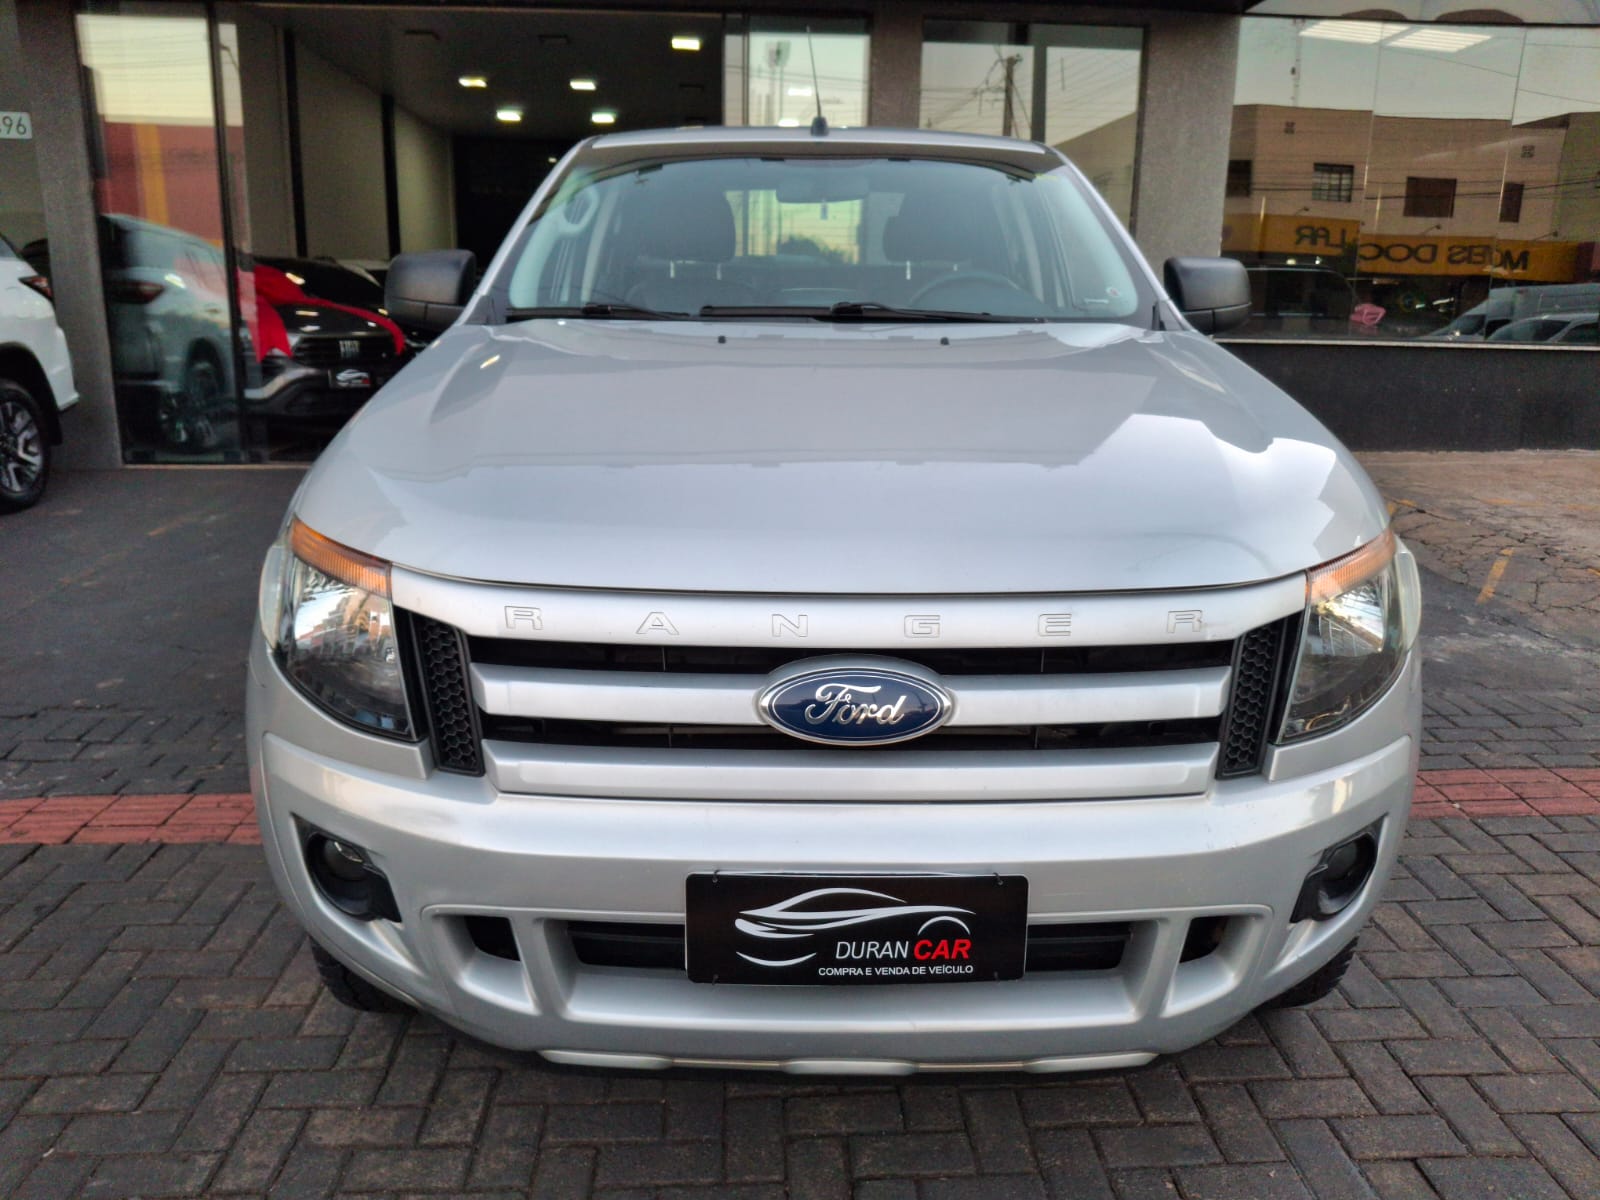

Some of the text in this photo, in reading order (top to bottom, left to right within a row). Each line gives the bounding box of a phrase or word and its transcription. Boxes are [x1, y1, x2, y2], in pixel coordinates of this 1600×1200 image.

[0, 115, 27, 135] 96
[504, 605, 1203, 638] RANGER
[804, 683, 907, 725] Ford
[835, 938, 972, 961] DURAN CAR
[818, 964, 974, 976] COMPRA E VENDA DE VEÍCULO
